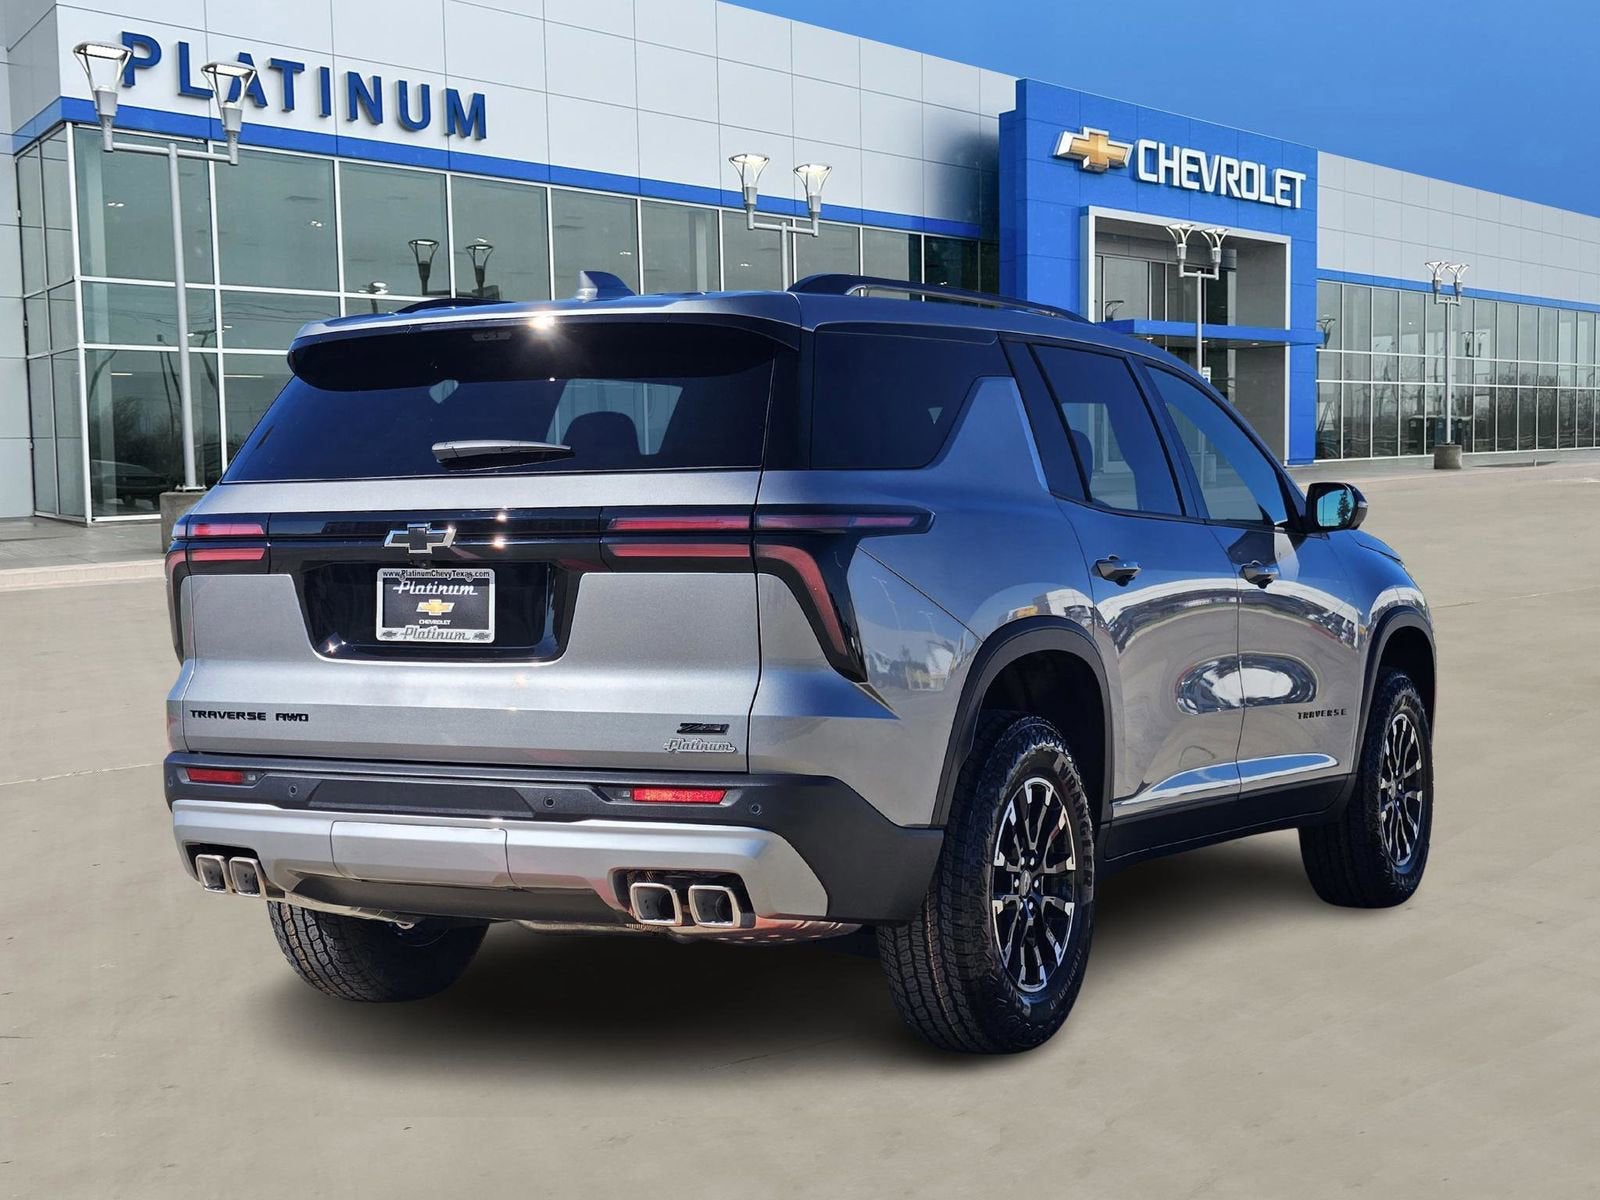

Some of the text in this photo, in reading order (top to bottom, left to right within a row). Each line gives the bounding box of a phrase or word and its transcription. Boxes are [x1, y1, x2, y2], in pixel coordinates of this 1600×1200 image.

[120, 31, 487, 140] PLATINUM
[1136, 139, 1306, 209] CHEVROLET
[382, 570, 490, 579] www.PlatinumChevyTexas.com
[392, 581, 478, 595] Platinum
[400, 626, 471, 640] Platinum
[190, 710, 309, 722] TRAVERSE AWD
[1297, 708, 1348, 719] TRAVERSE
[664, 738, 737, 753] Platinum
